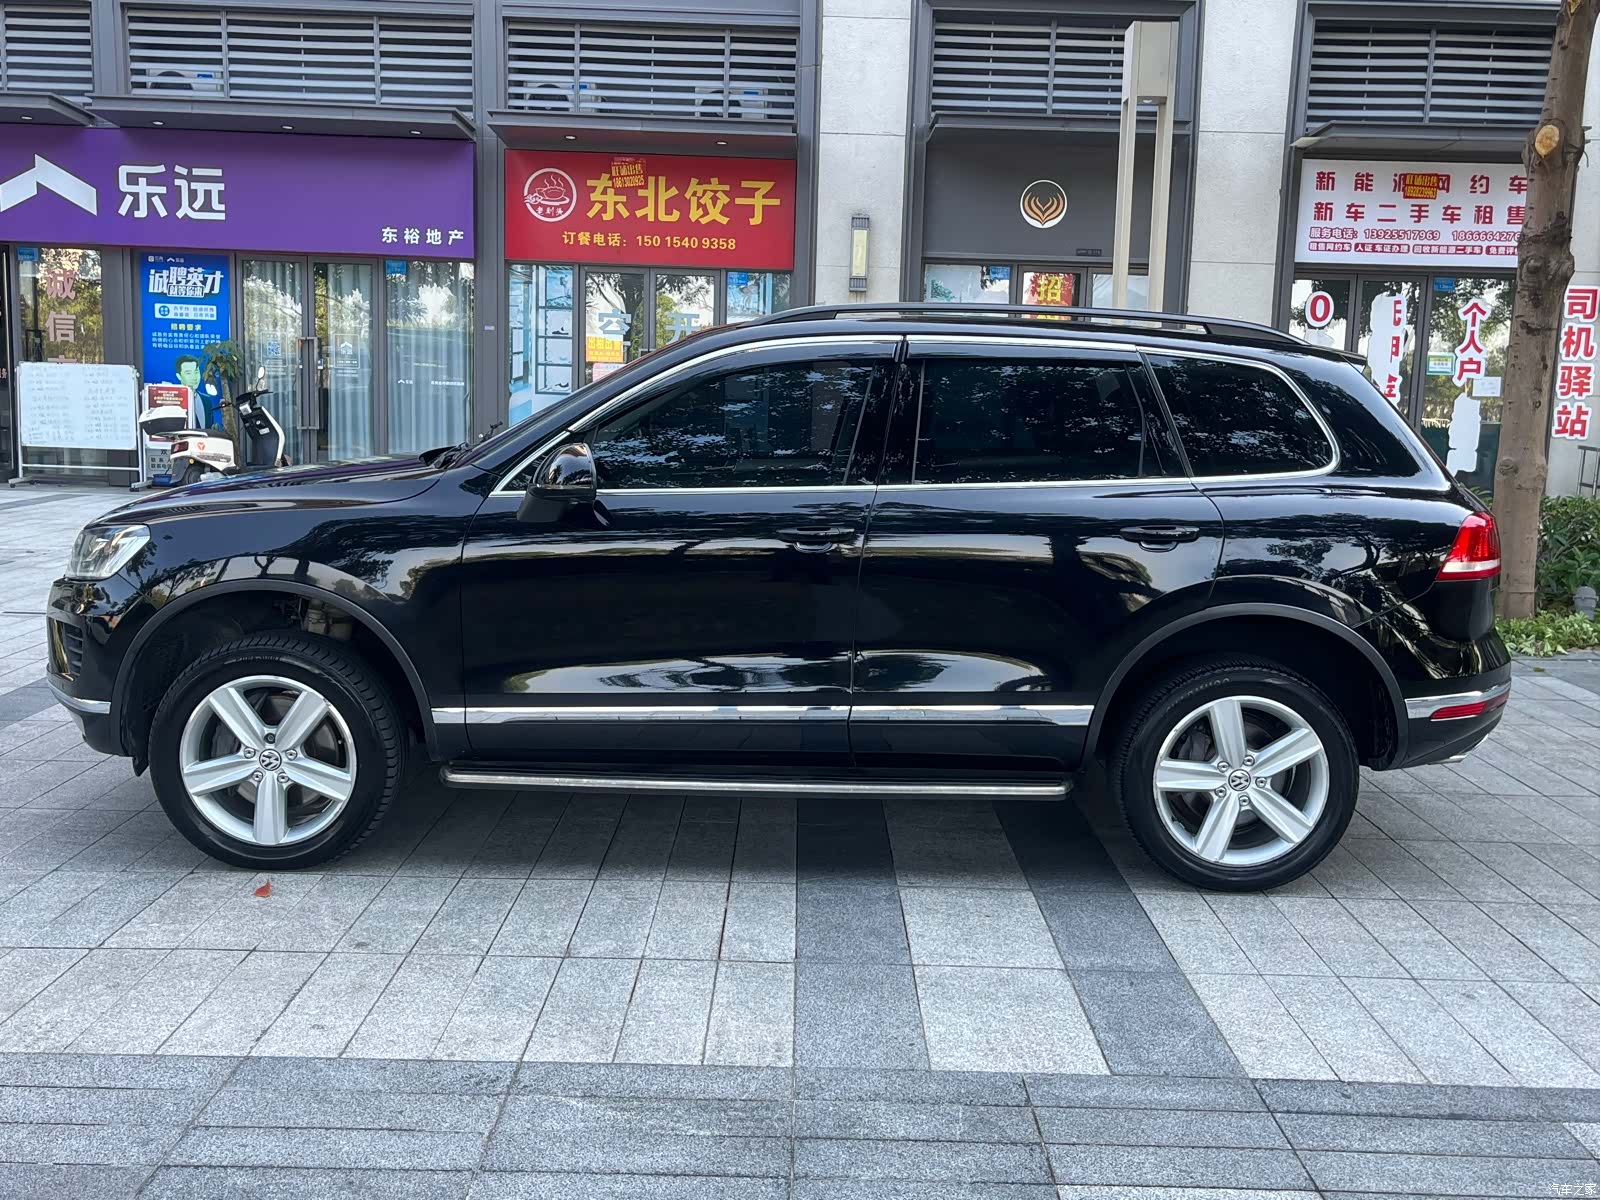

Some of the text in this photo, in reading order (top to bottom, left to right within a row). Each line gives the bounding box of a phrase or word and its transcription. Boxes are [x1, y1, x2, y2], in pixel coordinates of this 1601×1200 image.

[118, 164, 226, 221] 乐远
[586, 173, 781, 225] 东北饺子
[1313, 202, 1526, 224] 新车二手车租售
[381, 226, 465, 246] 东裕地产
[636, 235, 661, 247] 150
[665, 236, 699, 249] 1540
[702, 237, 736, 250] 9358
[1364, 228, 1441, 241] 13925517969
[149, 267, 224, 294] 诚聘英才
[45, 271, 77, 363] 诚信
[1457, 303, 1487, 381] 个人户
[1555, 288, 1598, 437] 司机驿站
